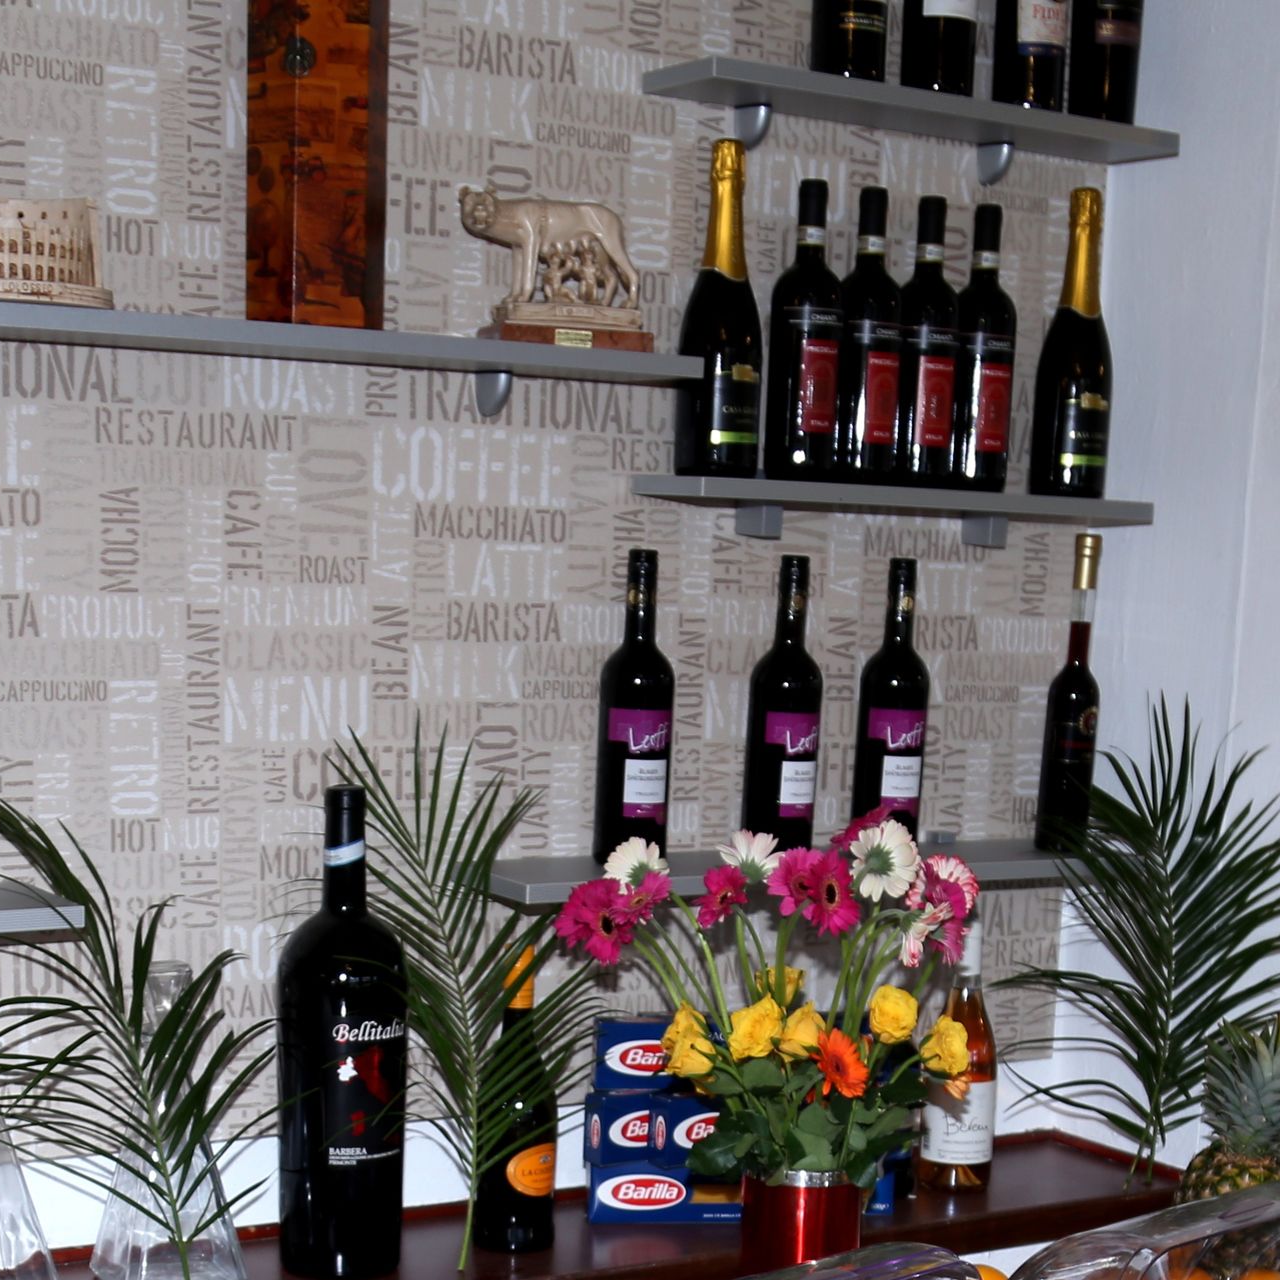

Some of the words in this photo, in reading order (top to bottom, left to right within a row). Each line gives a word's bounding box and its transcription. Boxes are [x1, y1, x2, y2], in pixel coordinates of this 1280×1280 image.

[388, 22, 419, 128] BEAN
[457, 25, 579, 86] BARISTA
[105, 214, 160, 257] HOT
[93, 406, 298, 453] RESTAURANT
[371, 427, 569, 508] COFFEE
[99, 486, 141, 594] MOCHA
[223, 488, 264, 584] CAFE
[413, 502, 569, 544] MACCHIATO
[298, 554, 369, 586] ROAST
[1021, 530, 1051, 618] MOCHA
[370, 604, 411, 702] BEAN
[445, 600, 562, 644] BARISTA
[824, 615, 859, 704] BEAN
[186, 601, 222, 816] RESTAURANT
[672, 611, 708, 804] RESTAURANT
[110, 817, 161, 854] HOT
[328, 1147, 369, 1156] BARBERA
[617, 1183, 680, 1202] Barilla
